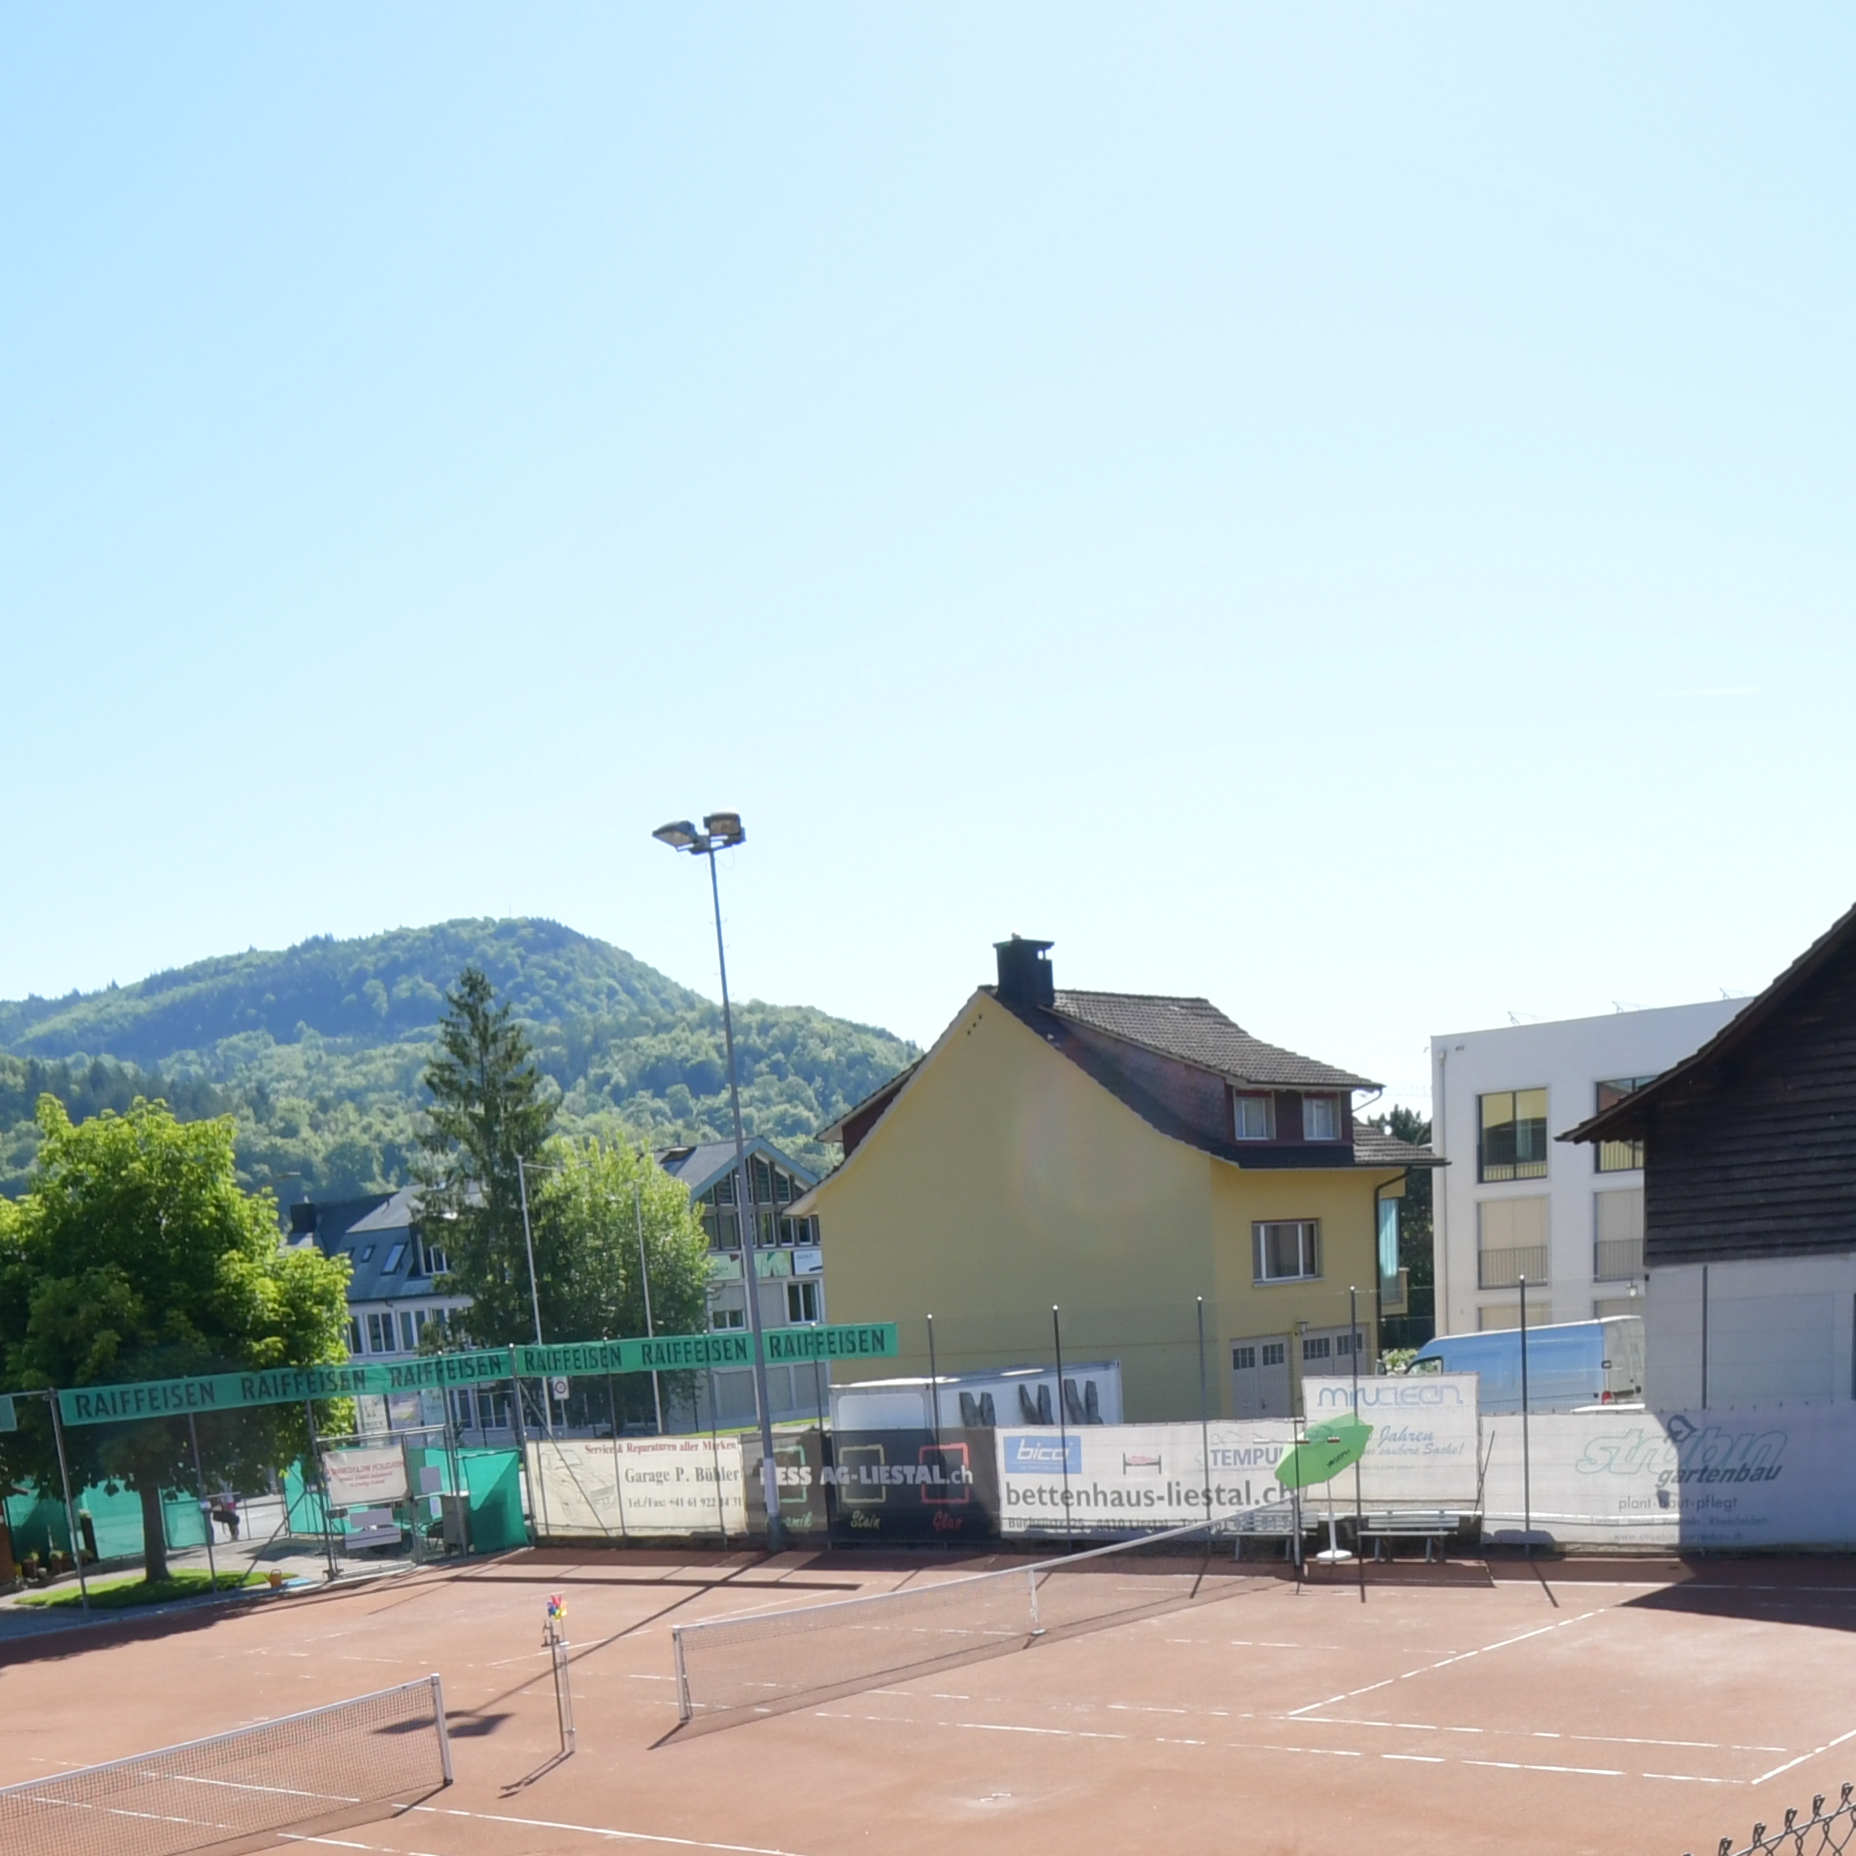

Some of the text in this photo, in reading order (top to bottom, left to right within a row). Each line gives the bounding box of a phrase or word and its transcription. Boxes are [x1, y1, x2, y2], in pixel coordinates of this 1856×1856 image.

[642, 1338, 748, 1365] RAIFFEISEN
[770, 1329, 885, 1358] RAIFFEISEN
[390, 1354, 502, 1388] RAIFFEISEN
[524, 1346, 622, 1372] RAIFFEISEN
[241, 1369, 366, 1400] RAIFFEISEN
[75, 1380, 216, 1418] RAIFFEISEN
[585, 1443, 616, 1455] Service
[627, 1441, 676, 1455] Reparaturen
[680, 1441, 699, 1452] aller
[1379, 1425, 1434, 1447] Jahren
[1209, 1448, 1283, 1467] TEMPU
[625, 1466, 739, 1486] Garage P. Bühler
[1655, 1463, 1783, 1489] gartenbau
[1006, 1479, 1295, 1508] bettenhaus-liestal.ch
[850, 1510, 880, 1529] Stein
